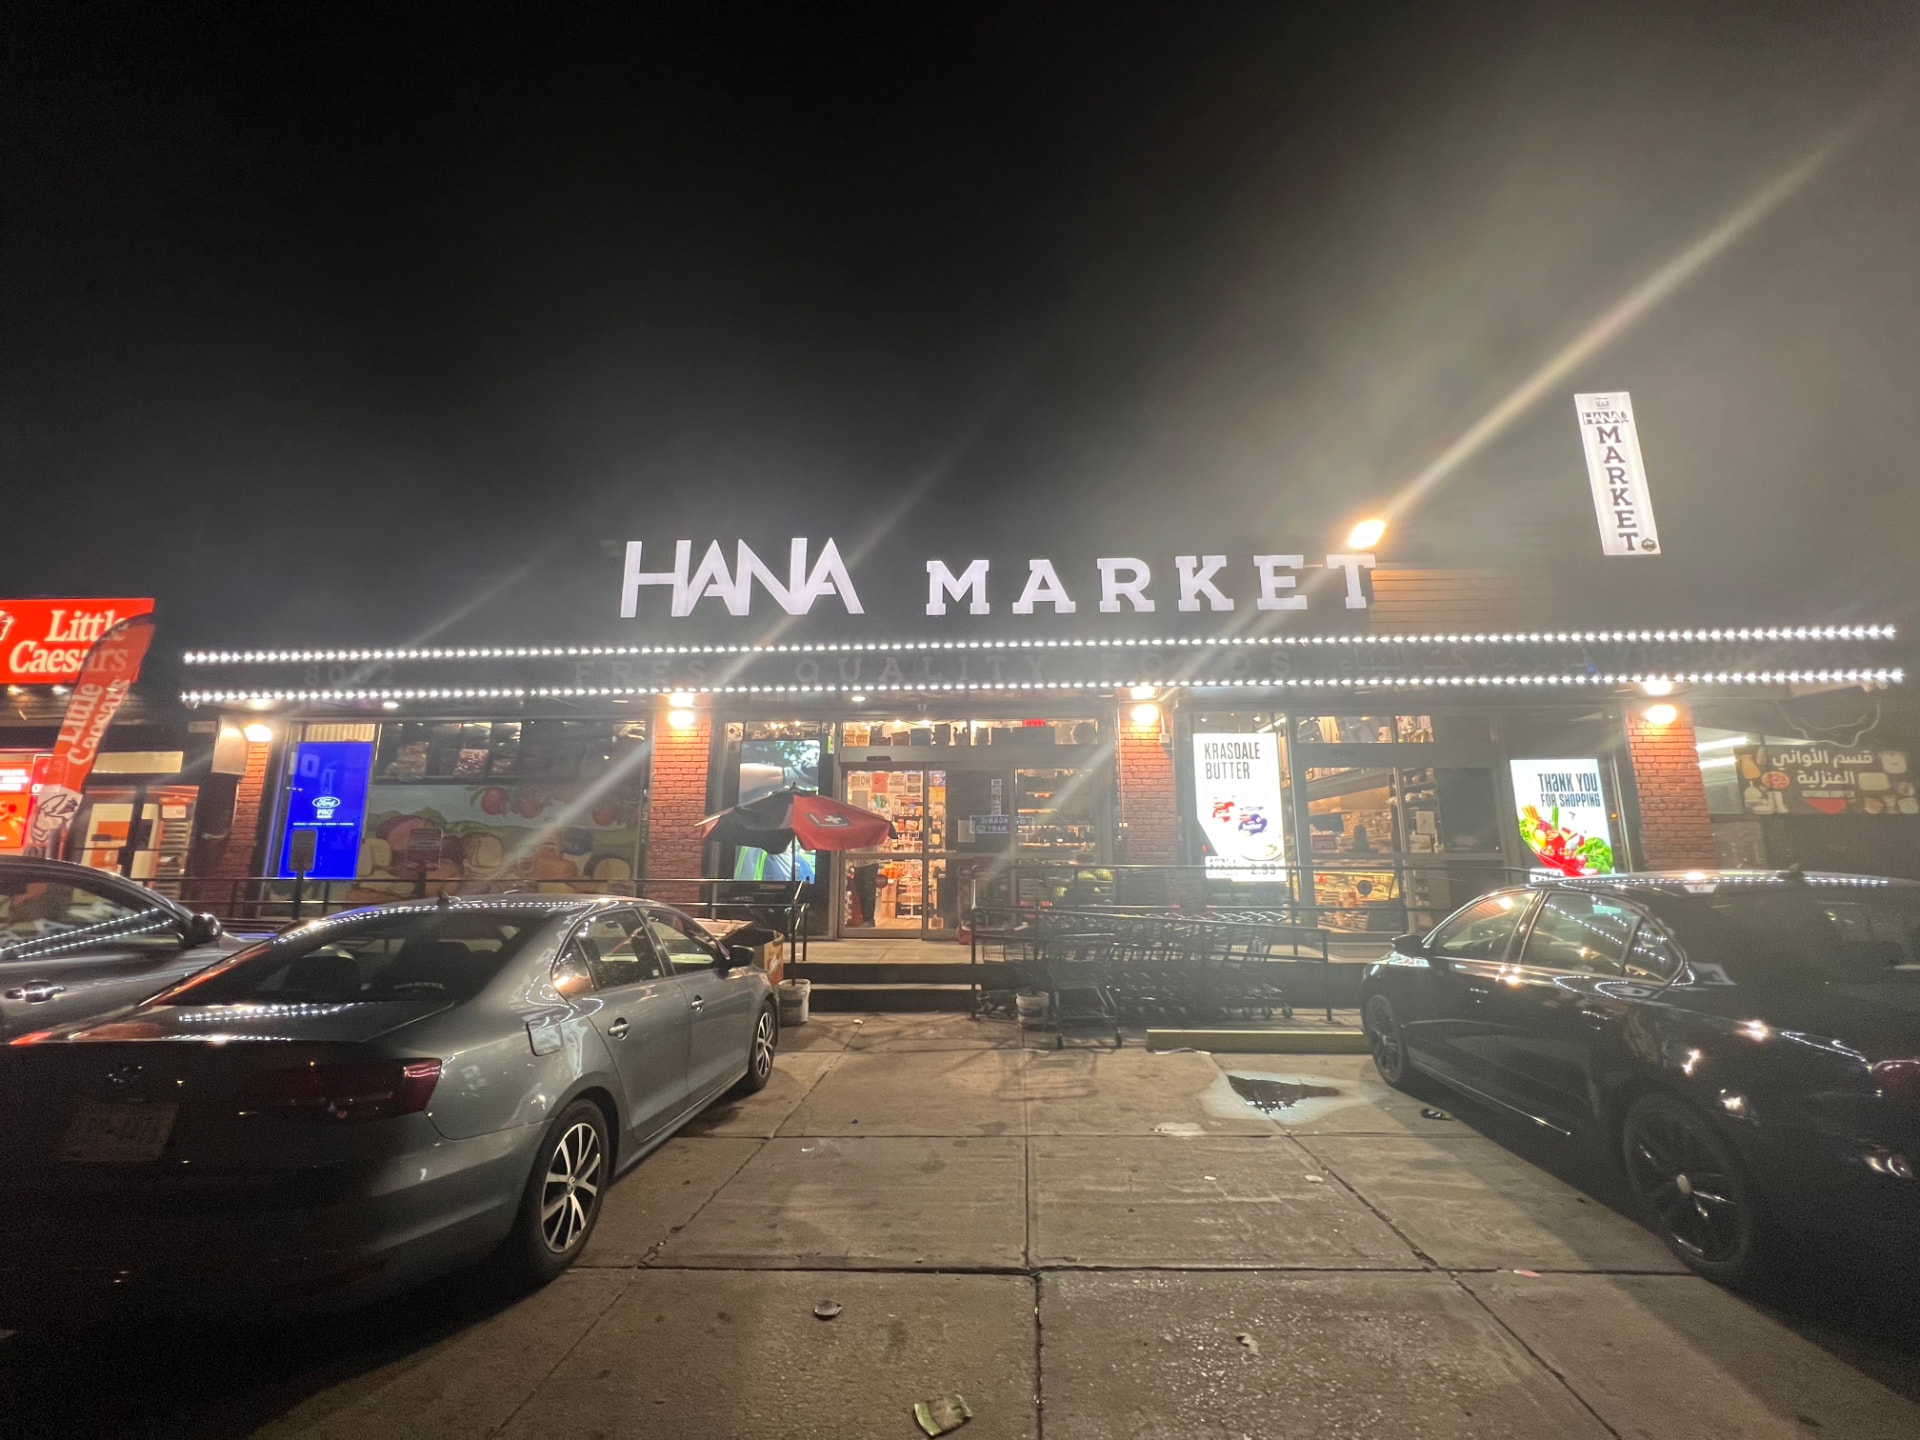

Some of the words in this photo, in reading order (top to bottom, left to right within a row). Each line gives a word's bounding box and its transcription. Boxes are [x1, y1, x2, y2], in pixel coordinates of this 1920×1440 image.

[1596, 425, 1639, 551] MARKET
[620, 537, 865, 618] HANA
[925, 554, 1376, 616] MARKET
[795, 657, 1048, 685] QUALITY
[1100, 651, 1290, 681] FODS
[57, 683, 104, 745] Little
[67, 679, 131, 765] Caesars
[1204, 742, 1261, 760] KRASDALE
[1772, 747, 1829, 771] الأواني
[1833, 750, 1873, 768] قسم
[1205, 762, 1251, 779] BUTTER
[1575, 773, 1598, 792] YOU
[1541, 794, 1557, 807] FOR
[1559, 793, 1601, 807] SHOPPING
